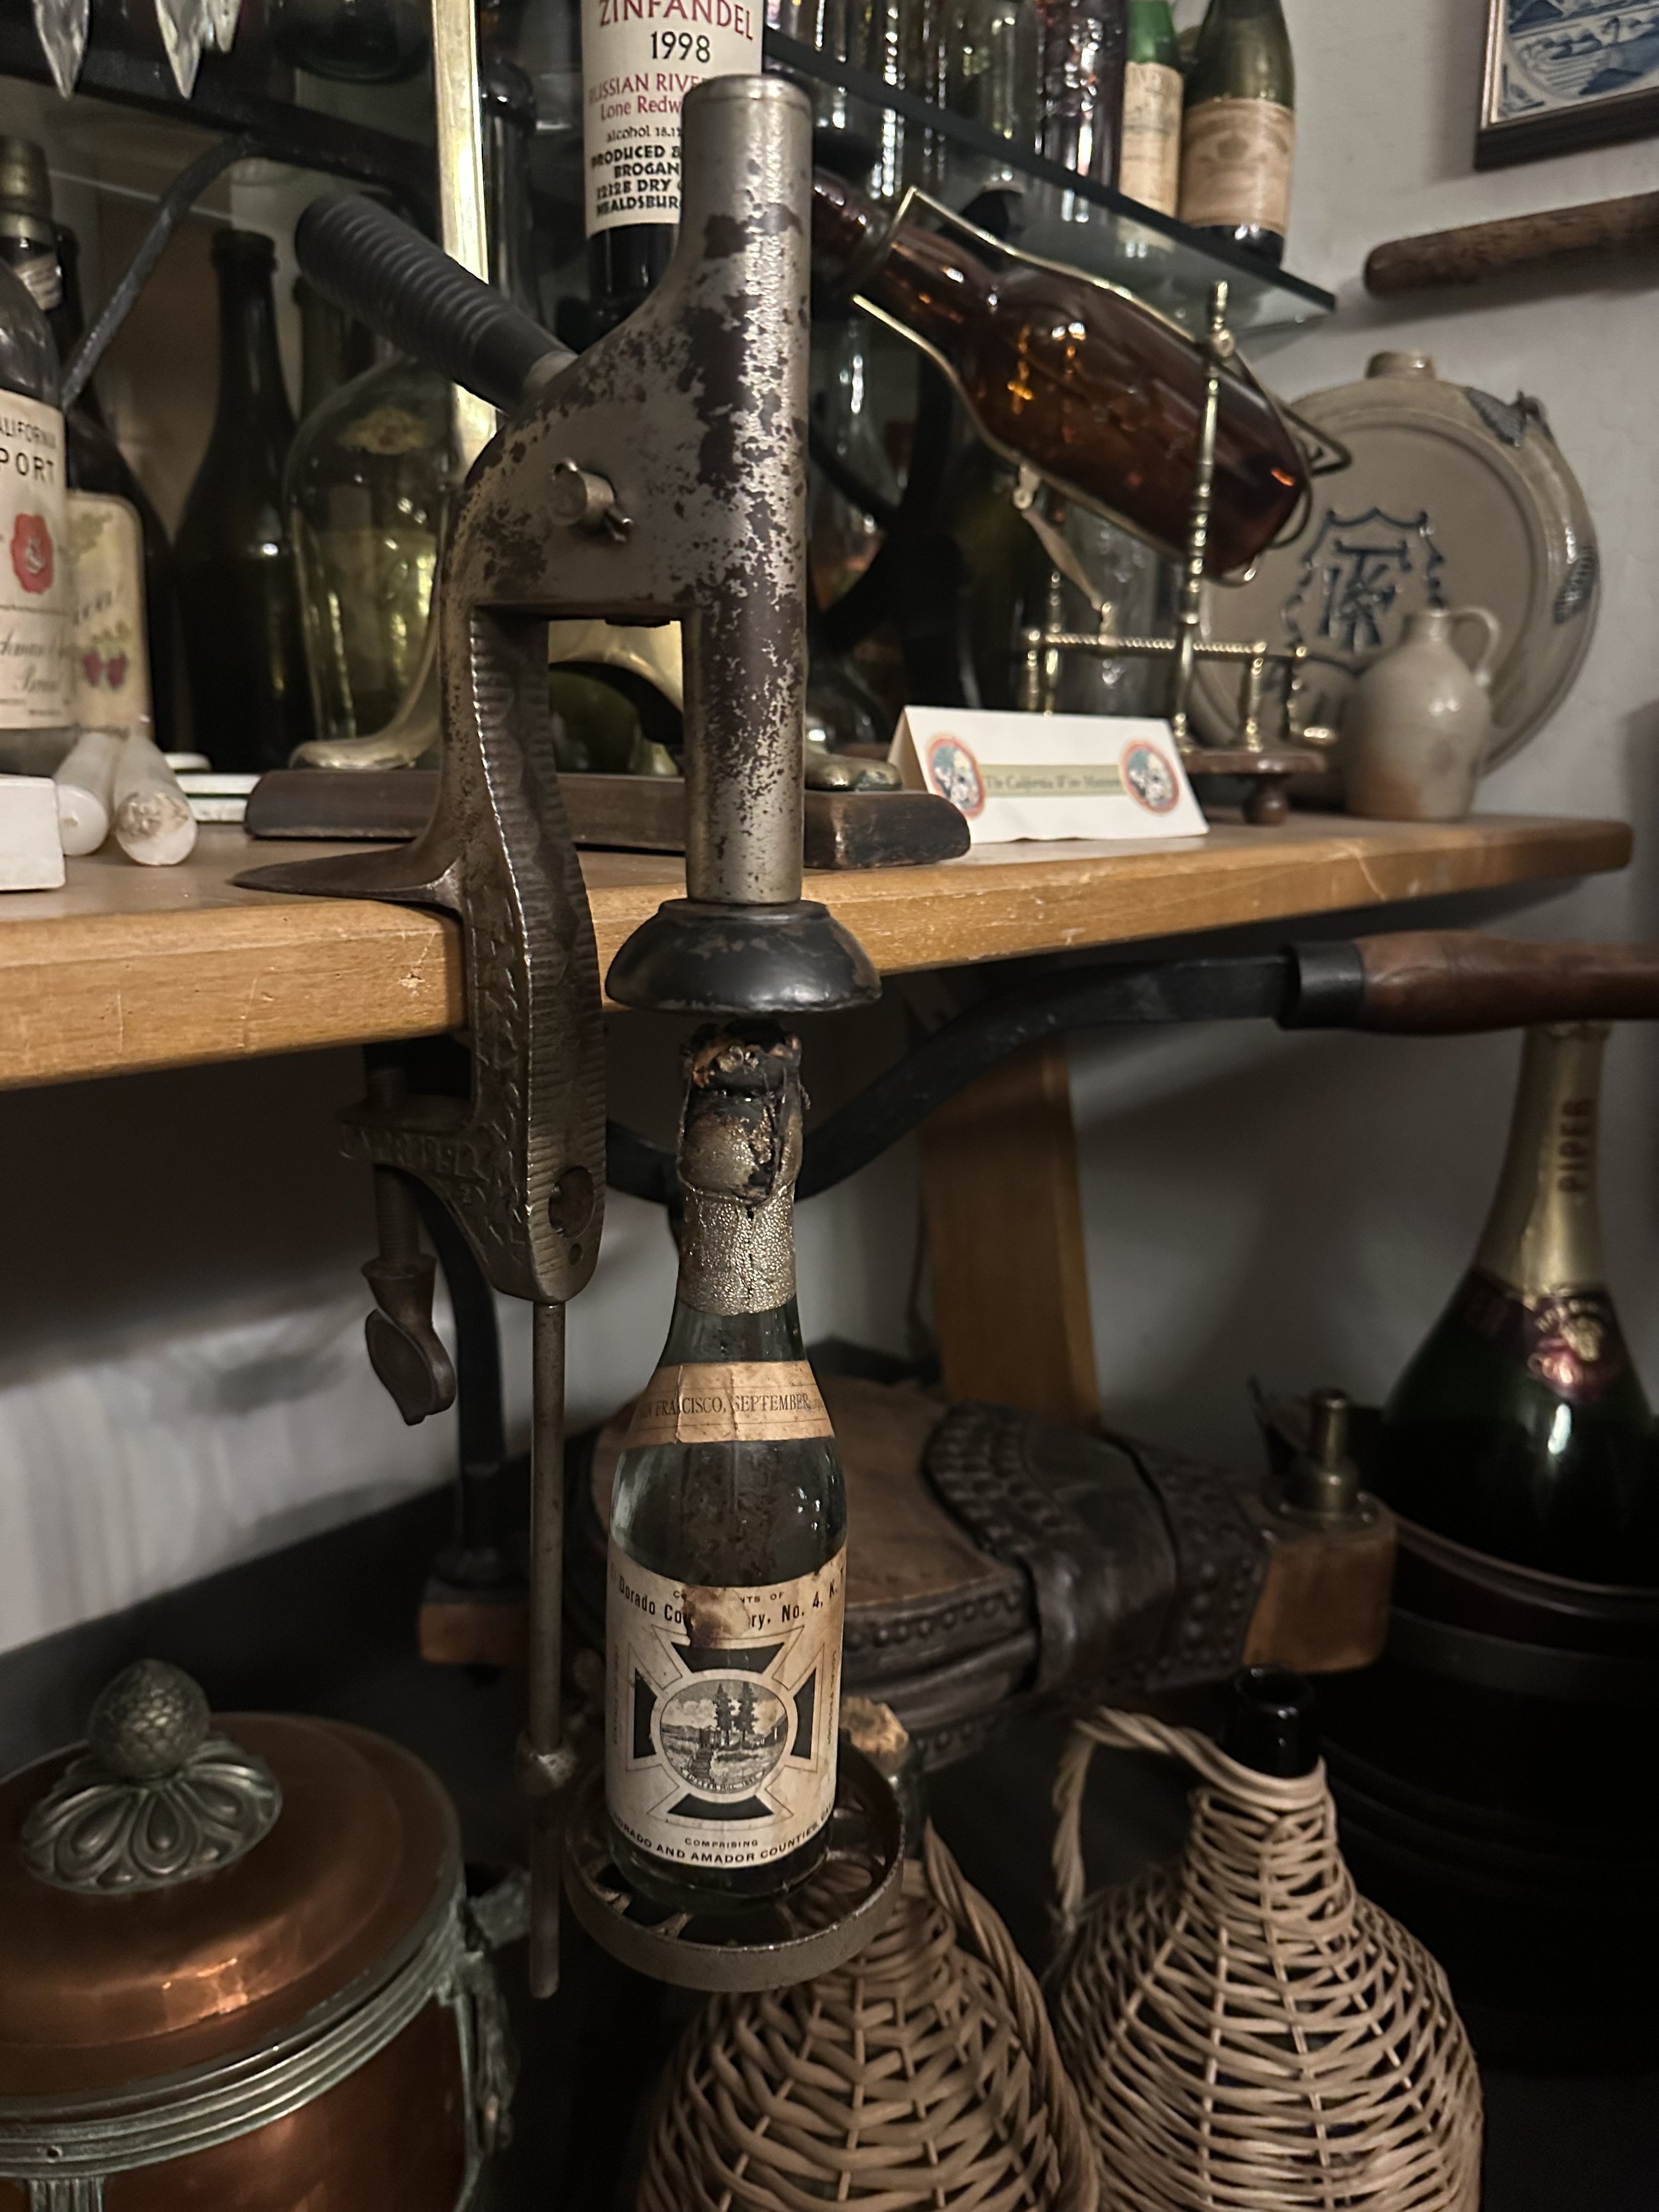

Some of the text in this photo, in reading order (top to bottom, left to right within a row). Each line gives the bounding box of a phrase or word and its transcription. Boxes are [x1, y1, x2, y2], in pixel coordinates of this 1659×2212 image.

[599, 0, 754, 41] ZINFANDEL
[650, 31, 711, 63] 1998
[589, 73, 649, 105] RUSSIAN
[601, 100, 631, 121] Lone
[607, 125, 651, 143] alcohol
[591, 145, 666, 169] PRODUCED
[613, 162, 680, 179] BROGAN
[637, 179, 672, 192] DRY
[1557, 1098, 1594, 1193] PIPER
[619, 1575, 656, 1615] Dorado
[782, 1604, 804, 1623] No.
[770, 1592, 784, 1601] OF
[685, 1837, 758, 1848] COMPRISING
[657, 1844, 685, 1859] AND
[691, 1852, 755, 1864] AMADOR
